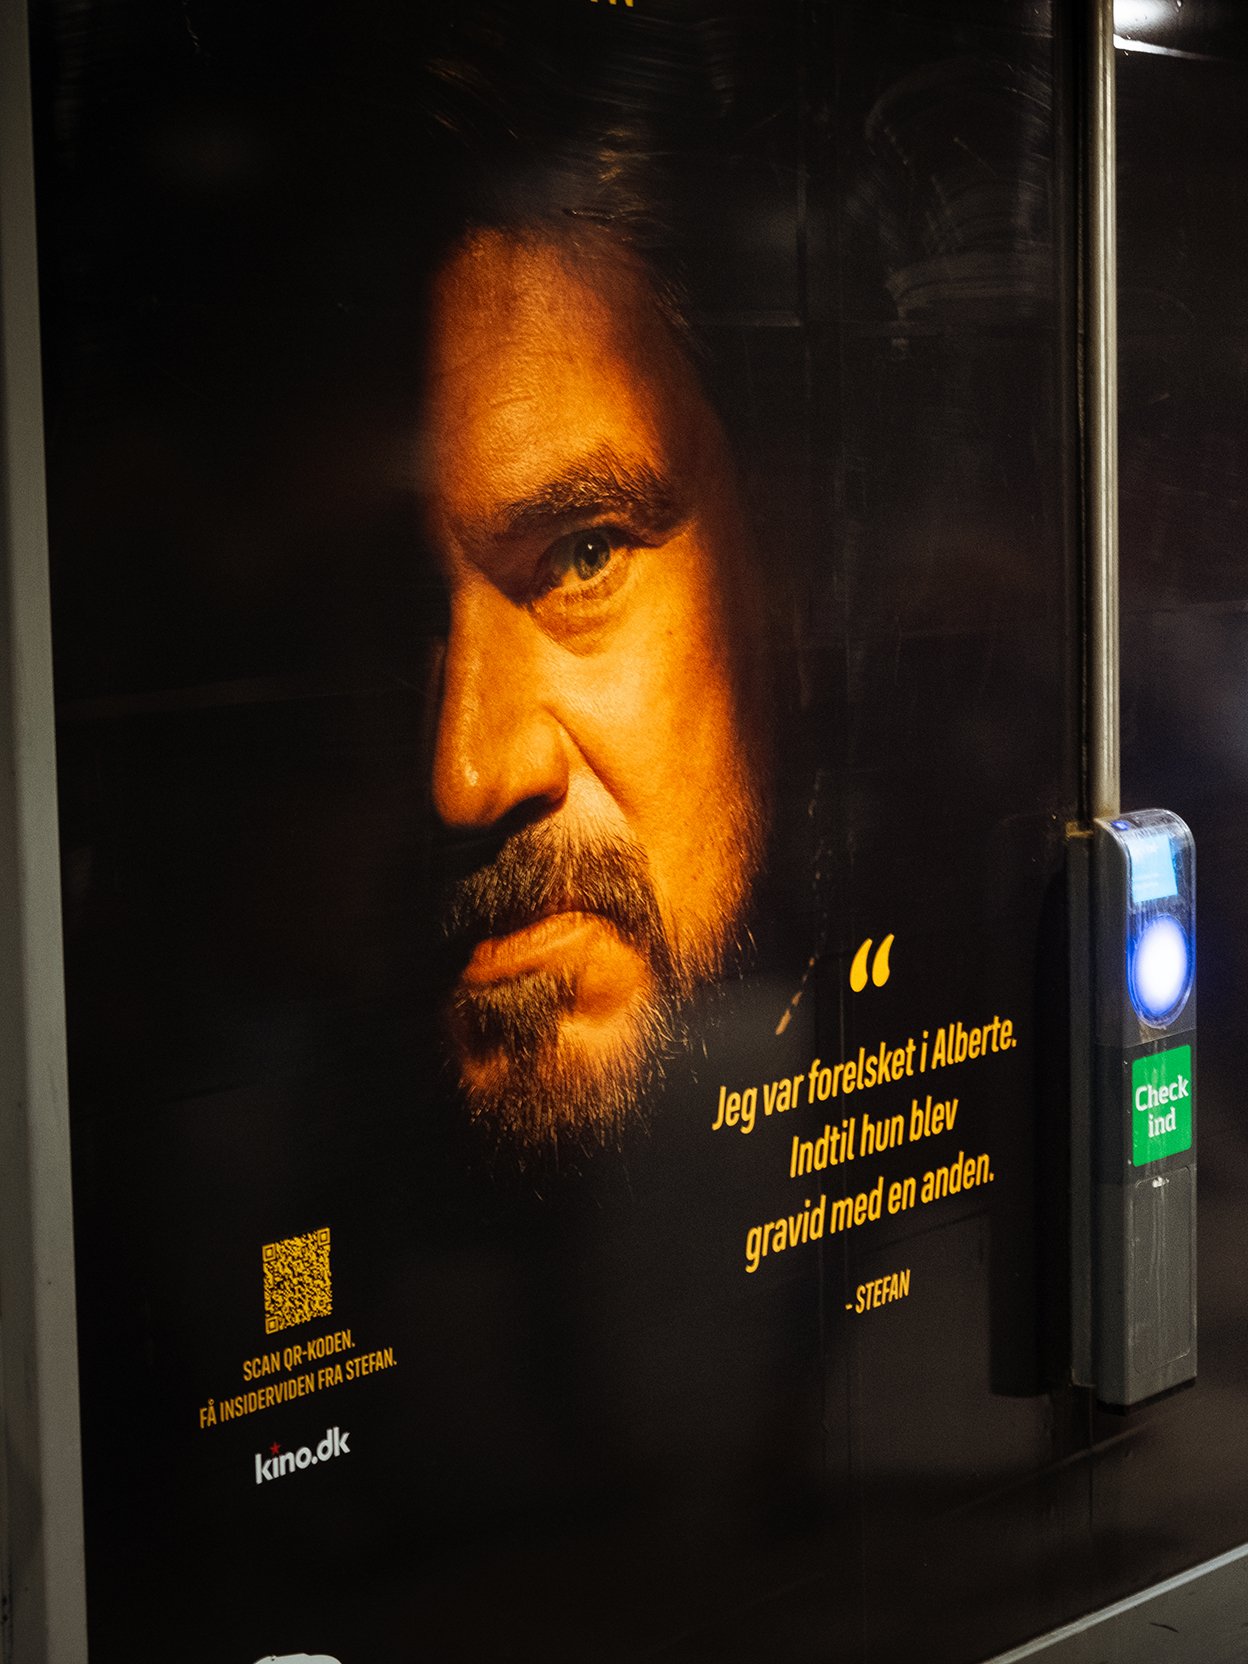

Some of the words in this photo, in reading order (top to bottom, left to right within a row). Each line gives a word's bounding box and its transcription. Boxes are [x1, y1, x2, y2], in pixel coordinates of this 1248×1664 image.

[712, 1086, 757, 1134] Jeg
[763, 1074, 805, 1116] var
[807, 1041, 917, 1104] forelsket
[919, 1030, 929, 1073] i
[931, 1016, 1018, 1070] Alberte.
[1135, 1074, 1189, 1111] Check
[789, 1117, 856, 1178] Indtil
[860, 1113, 904, 1157] hun
[909, 1095, 959, 1142] blev
[1148, 1106, 1177, 1138] ind
[744, 1194, 826, 1273] gravid
[829, 1175, 884, 1235] med
[888, 1177, 917, 1215] en
[920, 1151, 995, 1204] anden.
[855, 1269, 911, 1314] STEFAN
[243, 1352, 281, 1381] SCAN
[283, 1329, 355, 1371] QR-KODEN.
[200, 1398, 217, 1429] FÅ
[220, 1373, 315, 1423] INSIDERVIDEN
[318, 1364, 344, 1391] FRA
[346, 1347, 397, 1381] STEFAN.
[254, 1426, 350, 1484] kino.dk
